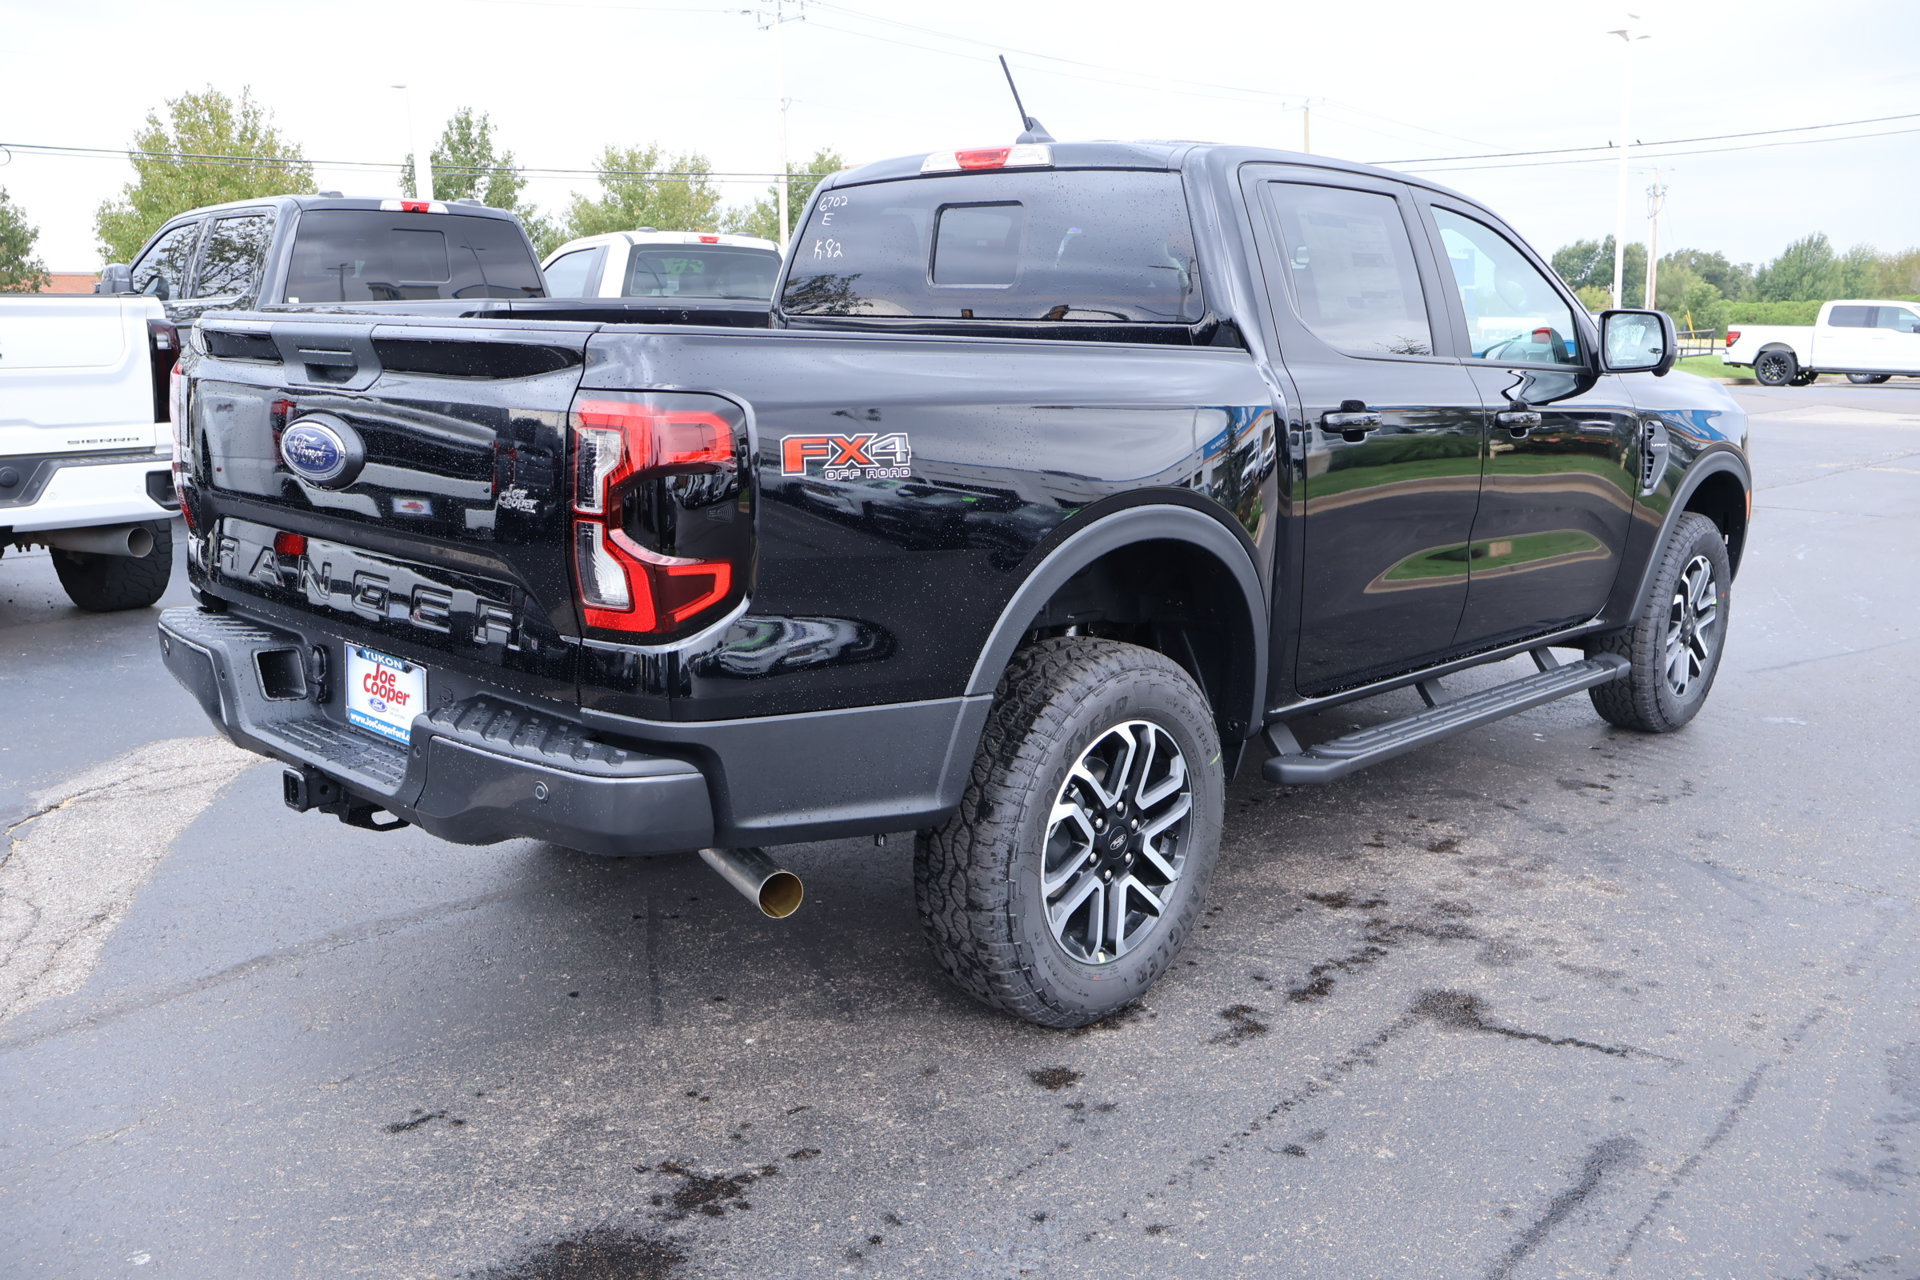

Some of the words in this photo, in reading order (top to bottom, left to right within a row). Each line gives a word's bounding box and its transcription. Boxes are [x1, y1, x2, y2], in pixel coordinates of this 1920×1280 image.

[819, 195, 848, 212] 6702
[821, 212, 835, 226] E
[293, 432, 325, 458] Ford
[780, 432, 912, 477] FX4
[825, 469, 861, 480] OFF
[865, 467, 911, 479] ROAD
[498, 491, 540, 510] Cooper
[213, 532, 523, 652] RANGER
[363, 650, 403, 670] YUKON
[372, 663, 396, 688] Joe
[363, 673, 410, 706] Cooper
